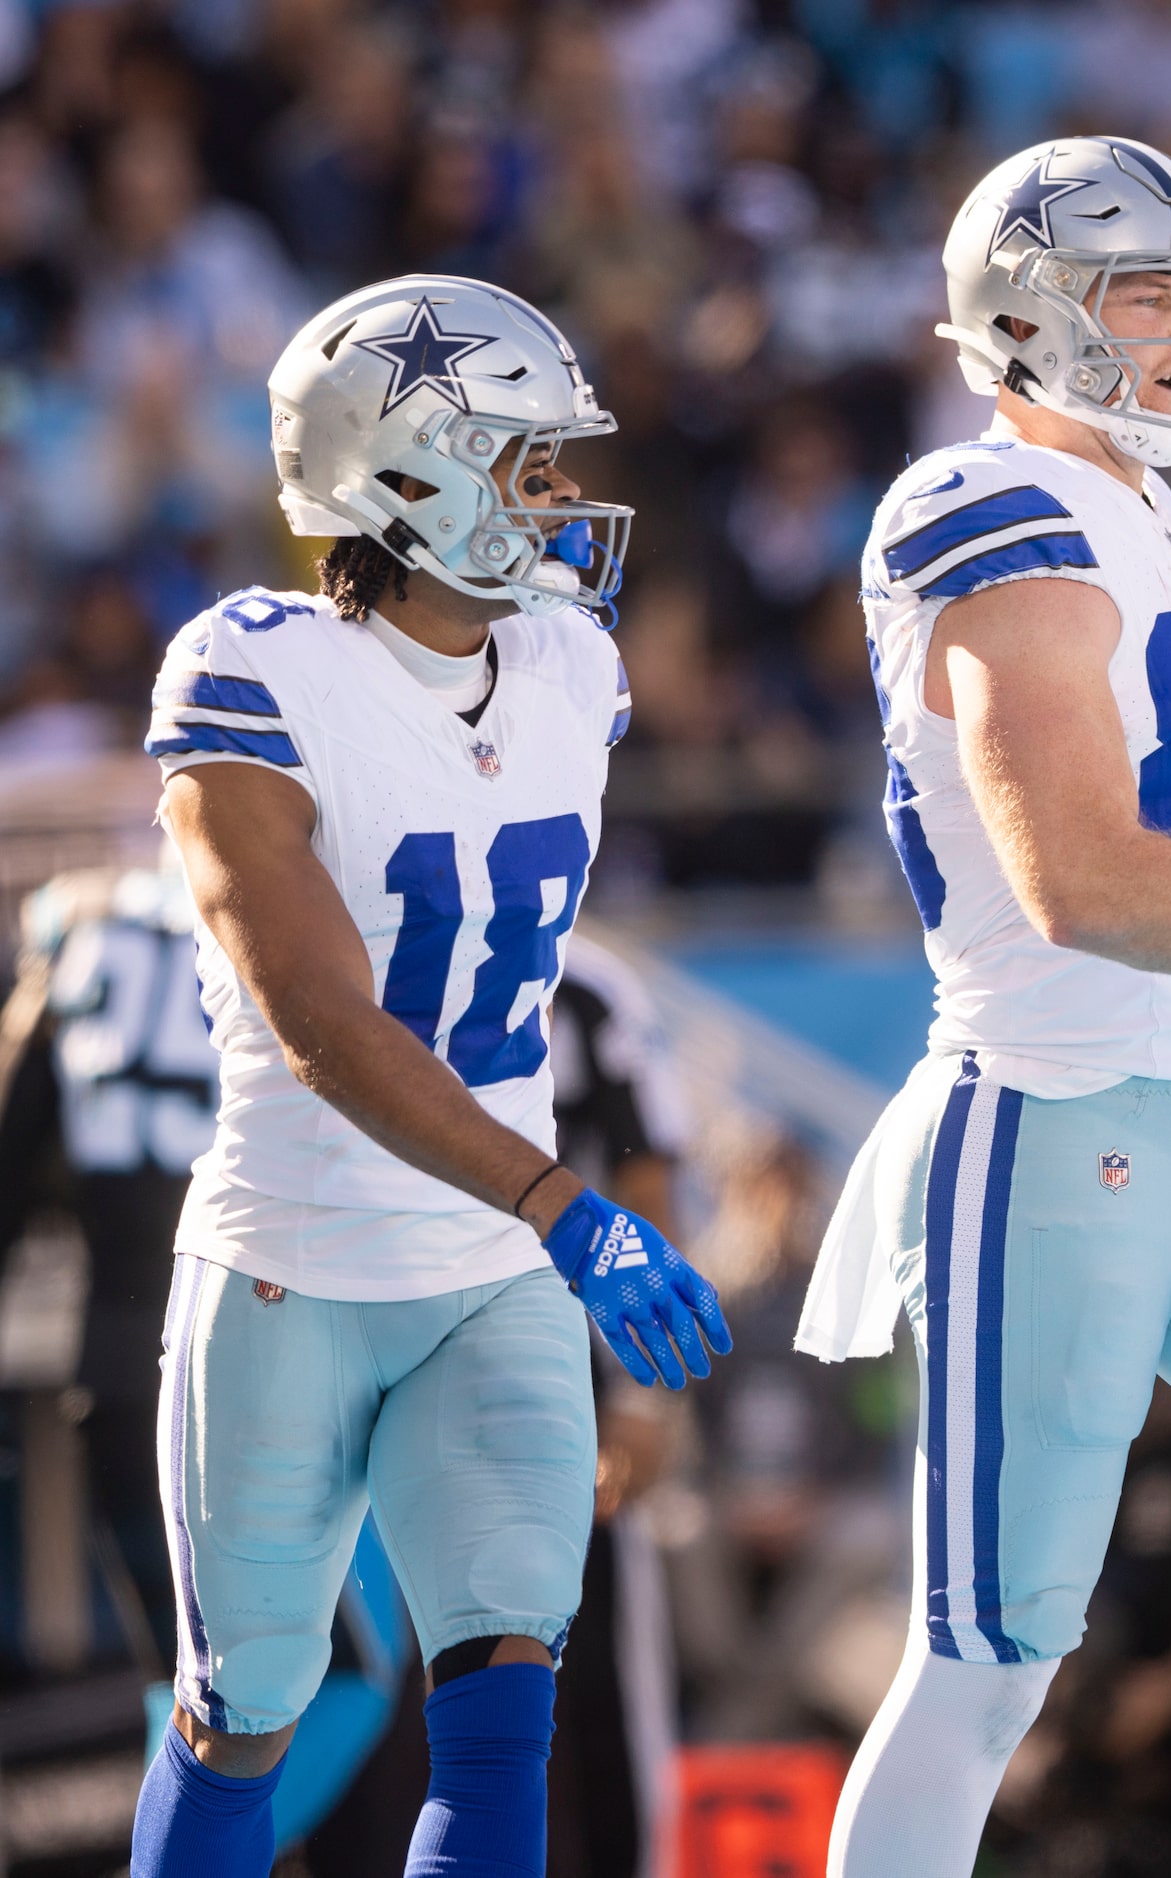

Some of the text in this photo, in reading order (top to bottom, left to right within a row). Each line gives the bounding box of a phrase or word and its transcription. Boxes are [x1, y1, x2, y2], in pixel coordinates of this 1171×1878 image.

[385, 812, 591, 1088] 18
[1105, 1168, 1127, 1186] NFL
[593, 1213, 628, 1277] adidas
[257, 1279, 282, 1299] NFL
